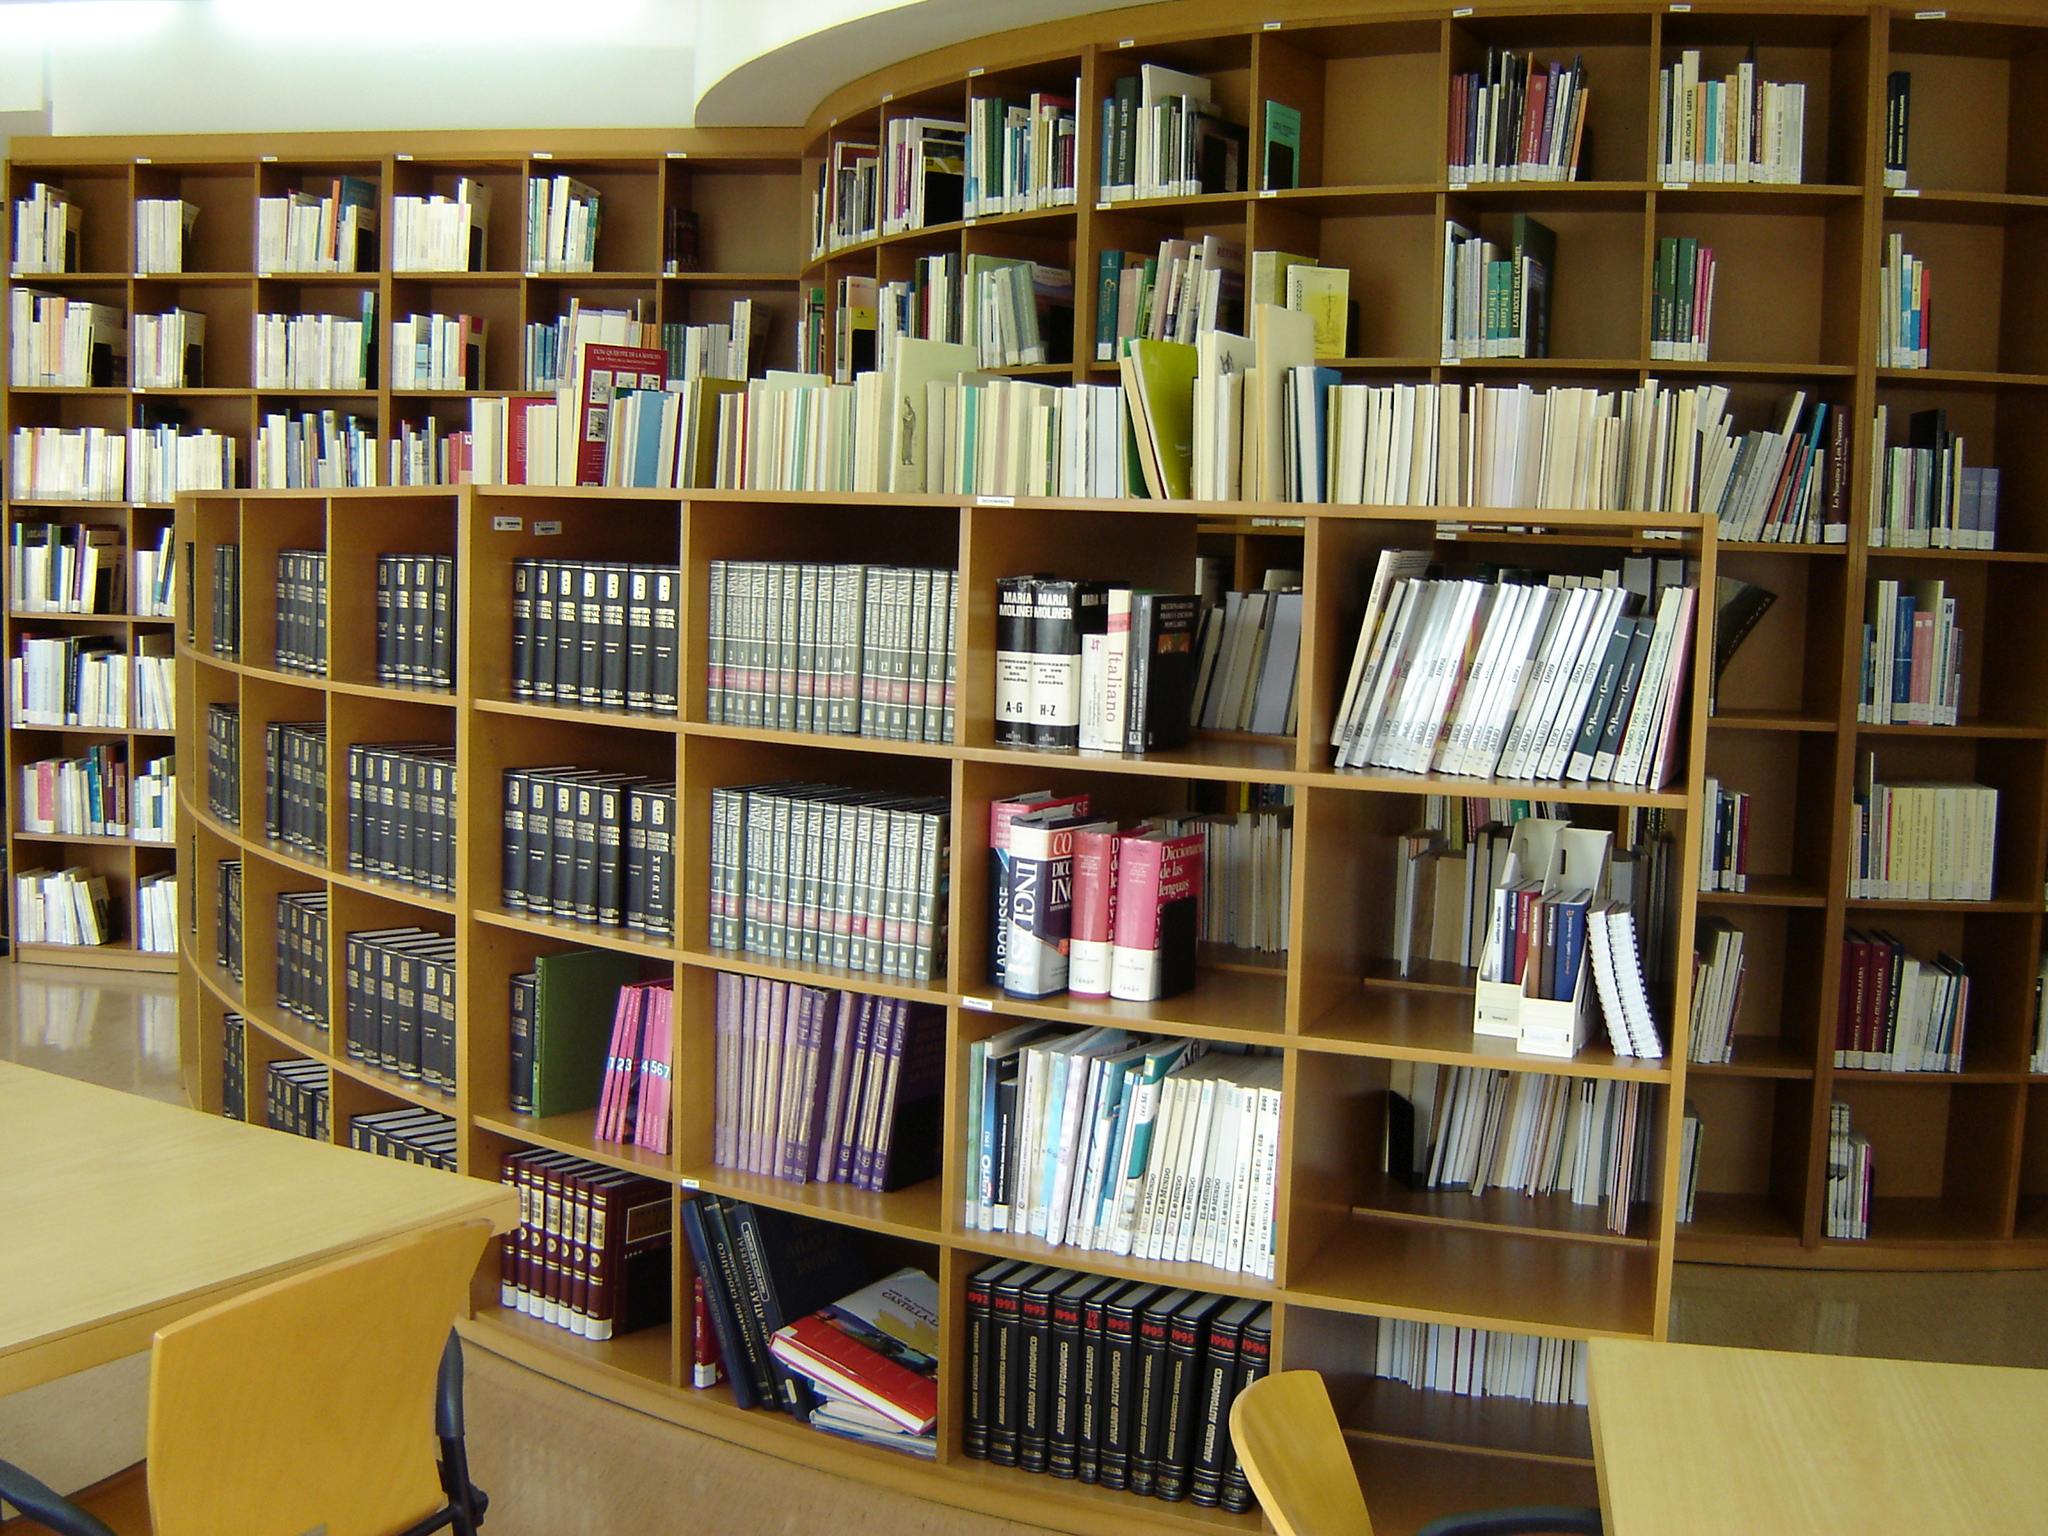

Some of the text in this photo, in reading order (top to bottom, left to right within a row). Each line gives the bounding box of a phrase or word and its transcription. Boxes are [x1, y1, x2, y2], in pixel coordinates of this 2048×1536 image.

[1034, 606, 1072, 620] MOLINER
[728, 650, 733, 660] 2
[767, 654, 772, 664] 5
[802, 656, 806, 666] 7
[881, 662, 888, 672] 12
[896, 662, 902, 673] 13
[912, 664, 918, 674] 14
[930, 664, 938, 675] 15
[1106, 651, 1124, 722] Italiano
[652, 856, 661, 899] INDEX
[1160, 862, 1172, 880] de
[1172, 862, 1183, 876] las
[1159, 880, 1190, 898] lenguas
[608, 1057, 614, 1069] 1
[616, 1058, 624, 1071] 2
[626, 1058, 632, 1070] 3
[642, 1060, 648, 1072] 4
[650, 1060, 658, 1073] 5
[657, 1062, 663, 1075] 6
[663, 1064, 670, 1078] 7
[1144, 1173, 1156, 1214] EL MUNDO
[1158, 1168, 1171, 1214] EL MUNDO
[1170, 1176, 1182, 1218] EL MUNDO
[1184, 1176, 1196, 1220] EL MUNDO
[1200, 1177, 1212, 1220] EL MUNDO
[1210, 1178, 1220, 1221] EL MUNDO
[737, 1236, 756, 1288] UNIVERSAL
[750, 1290, 766, 1318] ATLAS
[968, 1292, 988, 1304] 1992
[995, 1298, 1016, 1310] 1993
[1055, 1308, 1078, 1322] 1994
[734, 1303, 756, 1363] DICCIONARIO
[1142, 1323, 1164, 1338] 1995
[1171, 1330, 1194, 1344] 1995
[1210, 1334, 1235, 1349] 1996
[1085, 1346, 1094, 1394] EMPRESARIO
[1028, 1390, 1036, 1429] ANUARIO
[1056, 1396, 1066, 1435] ANUARIO
[1084, 1403, 1092, 1440] ANUARIO
[1110, 1406, 1119, 1444] ANUARIO
[1204, 1424, 1216, 1462] ANUARIO
